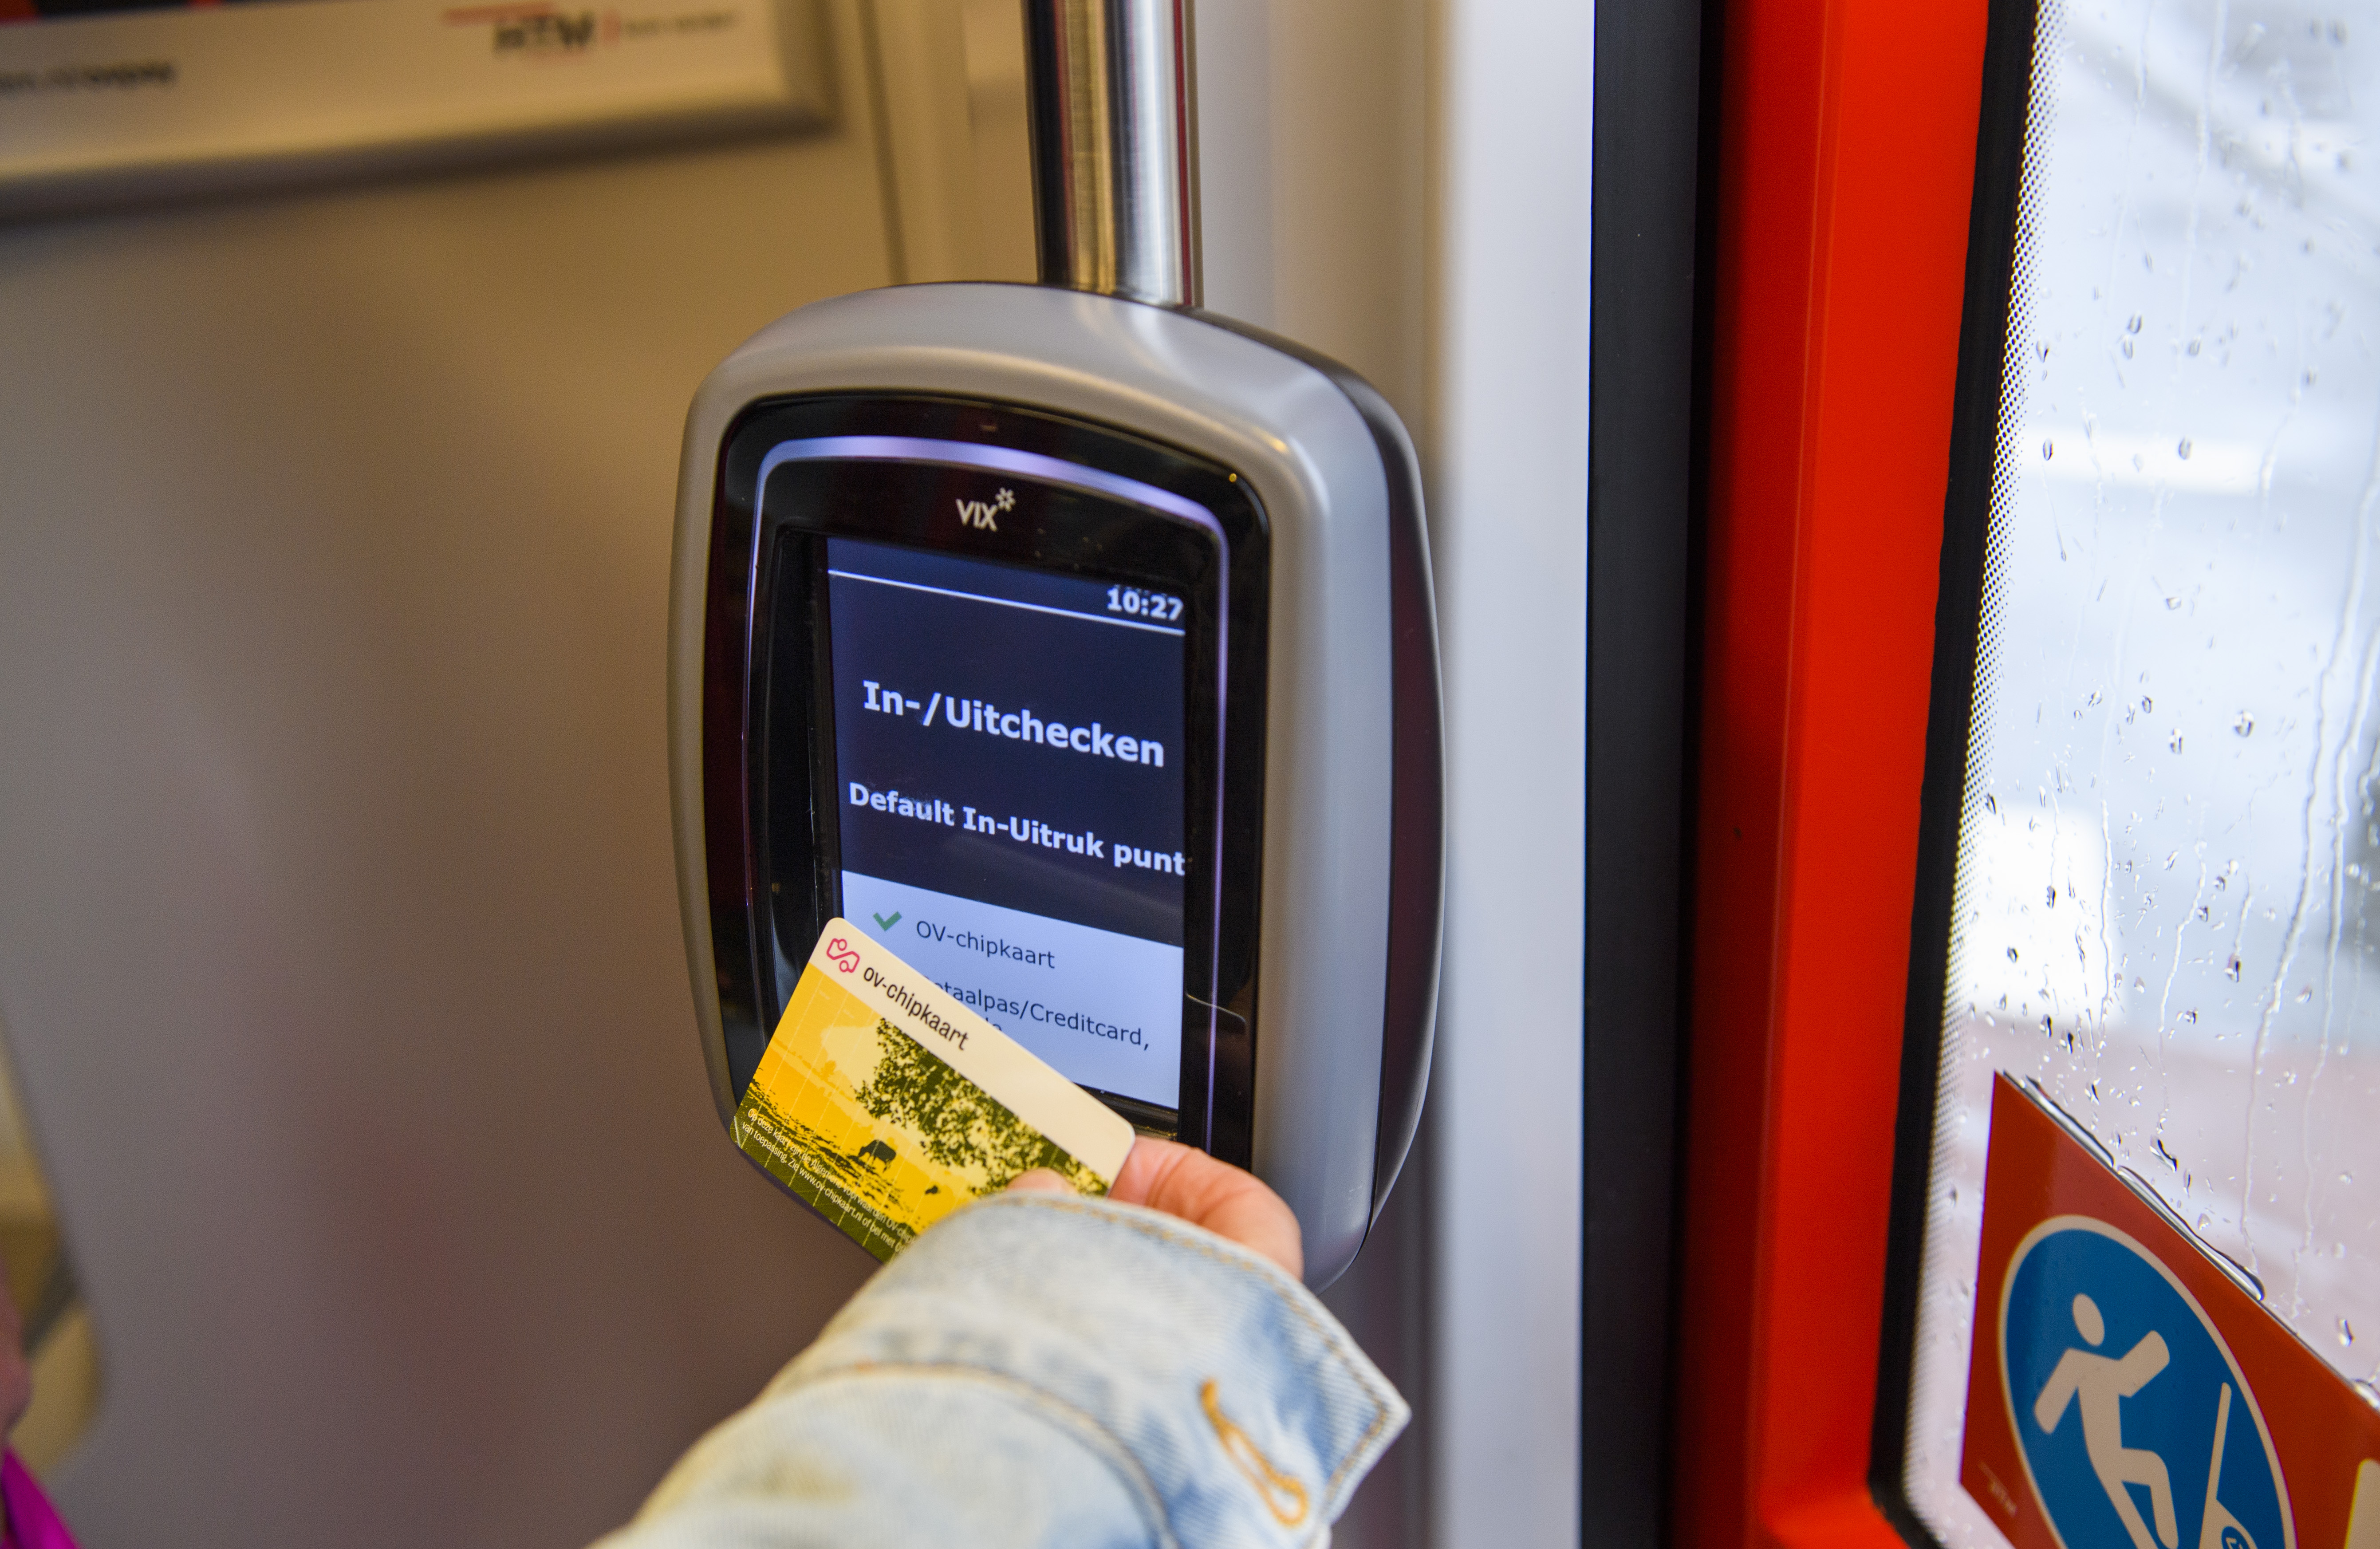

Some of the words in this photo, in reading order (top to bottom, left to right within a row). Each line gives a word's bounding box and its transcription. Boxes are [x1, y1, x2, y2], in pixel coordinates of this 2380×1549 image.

[955, 498, 998, 532] VIX
[1107, 587, 1184, 621] 10:27
[863, 680, 1164, 767] In-/Uitchecken
[849, 782, 955, 826] Default
[962, 806, 1104, 858] In-Uitruk
[1114, 843, 1185, 875] punt
[916, 920, 1055, 969] OV-chipkaart
[863, 966, 969, 1051] ov-chipkaart
[926, 976, 1149, 1051] taalpas/Creditcard,
[748, 1108, 758, 1121] Op
[757, 1117, 774, 1134] deze
[773, 1127, 791, 1148] kaart
[789, 1144, 802, 1157] zijn
[801, 1153, 812, 1164] de
[742, 1122, 754, 1135] van
[753, 1130, 788, 1164] toepassing.
[788, 1157, 800, 1171] Zie
[799, 1167, 864, 1222] www.ov-chipkaart.nl
[861, 1217, 872, 1228] of
[869, 1220, 883, 1237] bel
